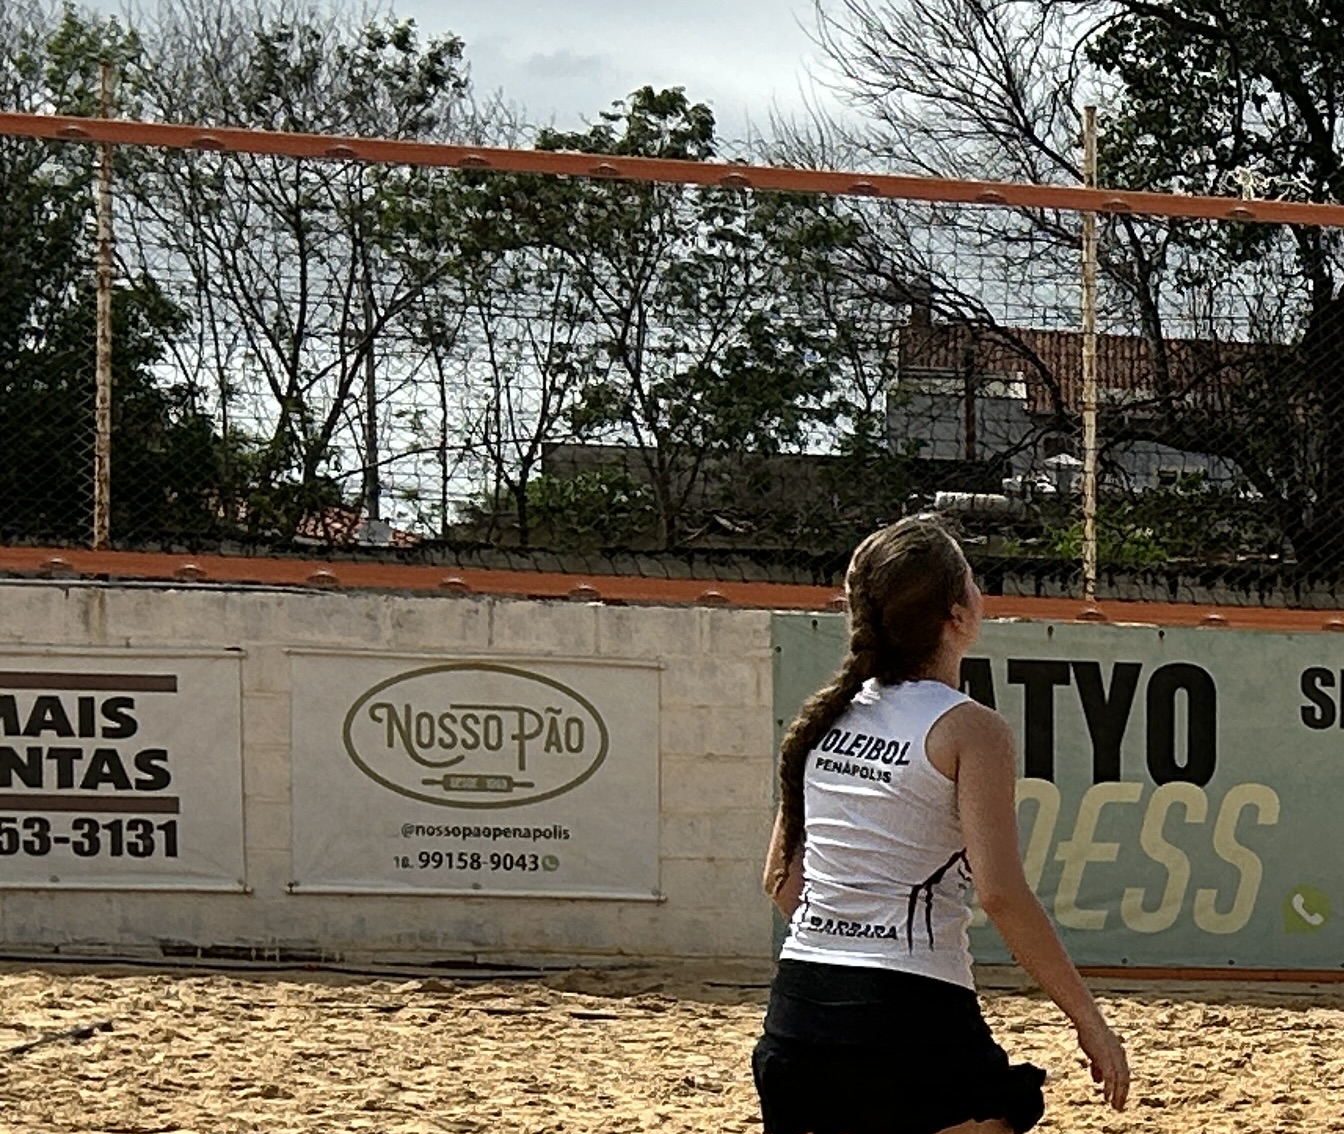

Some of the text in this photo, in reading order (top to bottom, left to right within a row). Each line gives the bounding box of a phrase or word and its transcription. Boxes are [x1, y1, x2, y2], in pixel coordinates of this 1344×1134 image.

[369, 703, 502, 768] NOSSO
[820, 728, 911, 766] OLEIBOL
[401, 823, 570, 841] @nossopaopenapolis
[418, 851, 540, 872] 99158-9043
